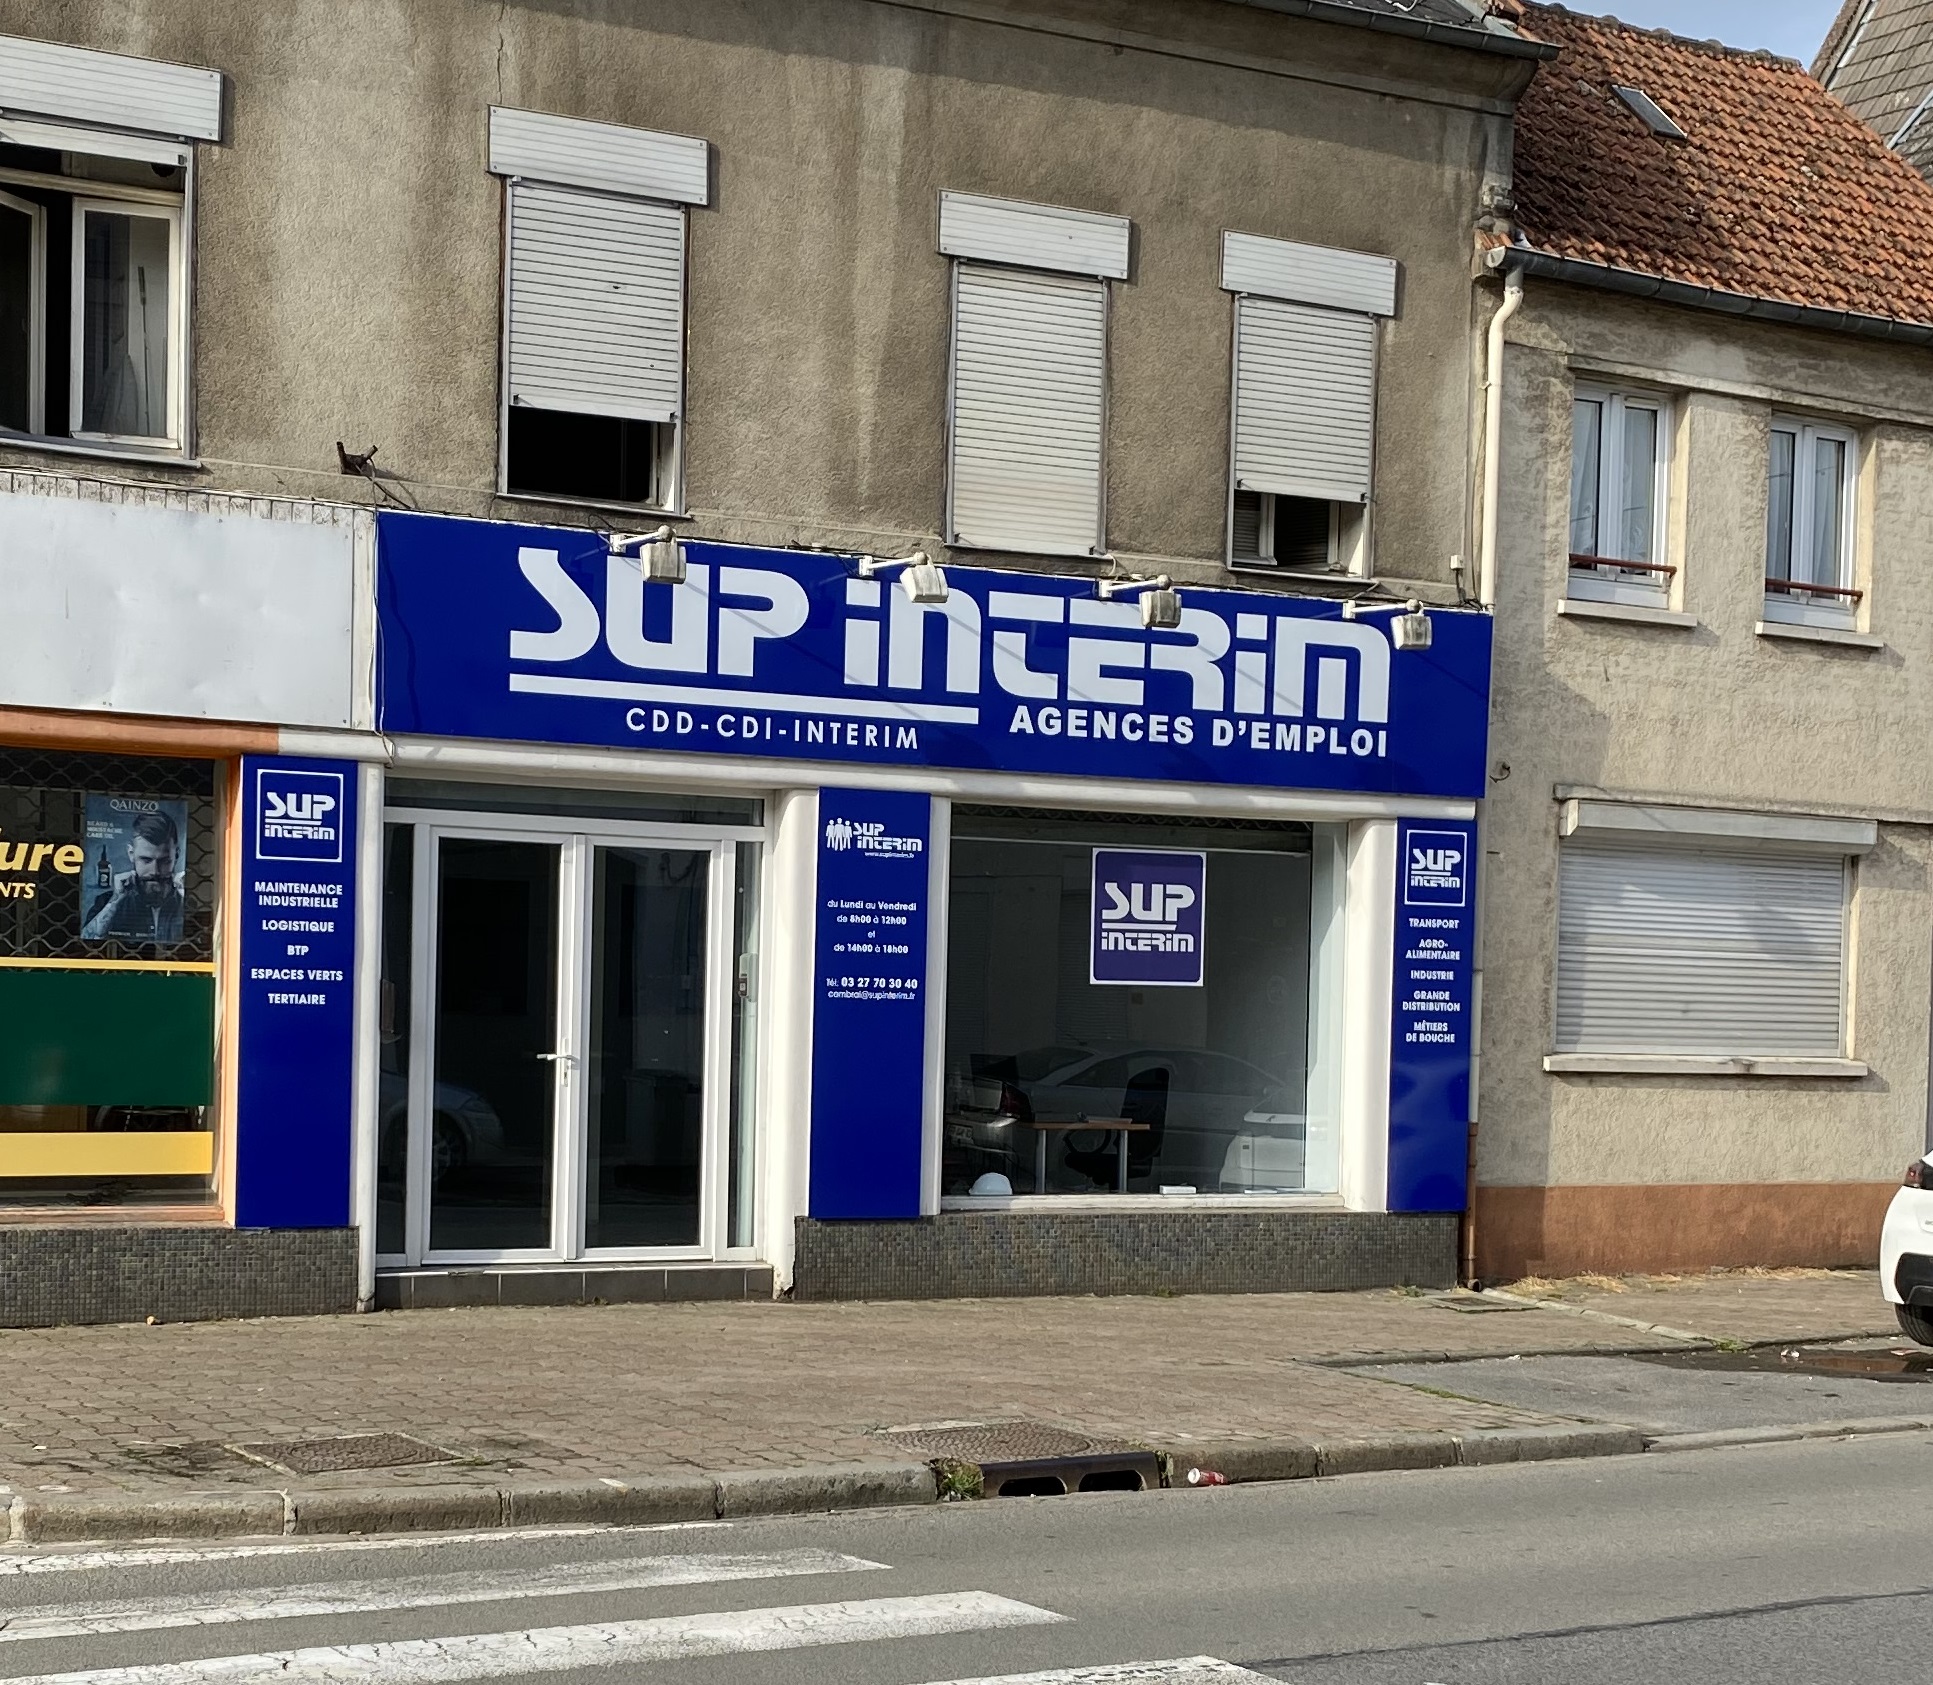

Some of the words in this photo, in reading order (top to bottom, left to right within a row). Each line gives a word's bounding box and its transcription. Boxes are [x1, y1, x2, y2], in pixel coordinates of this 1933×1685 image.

[510, 547, 809, 677] SUP
[1009, 705, 1194, 745] AGENCES
[1213, 719, 1387, 758] D'EMPLOI
[109, 799, 160, 813] QAINZO
[265, 791, 336, 820] SUP
[853, 822, 885, 836] SUP
[0, 841, 85, 874] ure
[1411, 849, 1462, 871] SUP
[254, 881, 343, 896] MAINTENANCE
[258, 894, 339, 908] INDUSTRIELLE
[827, 900, 839, 908] du
[840, 900, 864, 909] Lundi
[865, 902, 876, 910] au
[878, 901, 917, 911] Vendredi
[1102, 882, 1196, 922] SUP
[262, 919, 335, 933] LOGISTIQUE
[836, 915, 848, 923] de
[849, 915, 872, 924] 8h00
[873, 915, 880, 924] à
[881, 916, 907, 925] 12h00
[1409, 917, 1460, 929] TRANSPORT
[867, 930, 876, 938] et
[287, 944, 310, 956] BTP
[833, 943, 846, 952] de
[847, 943, 873, 953] 14h00
[874, 944, 881, 953] à
[882, 944, 909, 954] 18h00
[1419, 938, 1449, 949] AGRO-
[1405, 949, 1461, 961] ALIMENTAIRE
[251, 968, 305, 981] ESPACES
[307, 969, 344, 982] VERTS
[1411, 969, 1454, 981] INDUSTRIE
[841, 976, 855, 987] 03
[857, 977, 870, 988] 27
[873, 977, 886, 989] 70
[888, 978, 902, 989] 30
[904, 978, 918, 989] 40
[267, 992, 326, 1005] TERTIAIRE
[827, 989, 916, 1001] cambrai@supinterim.fr
[1413, 990, 1450, 1001] GRANDE
[1402, 1000, 1461, 1012] DISTRIBUTION
[1405, 1032, 1417, 1043] DE
[1419, 1033, 1456, 1043] BOUCHE
